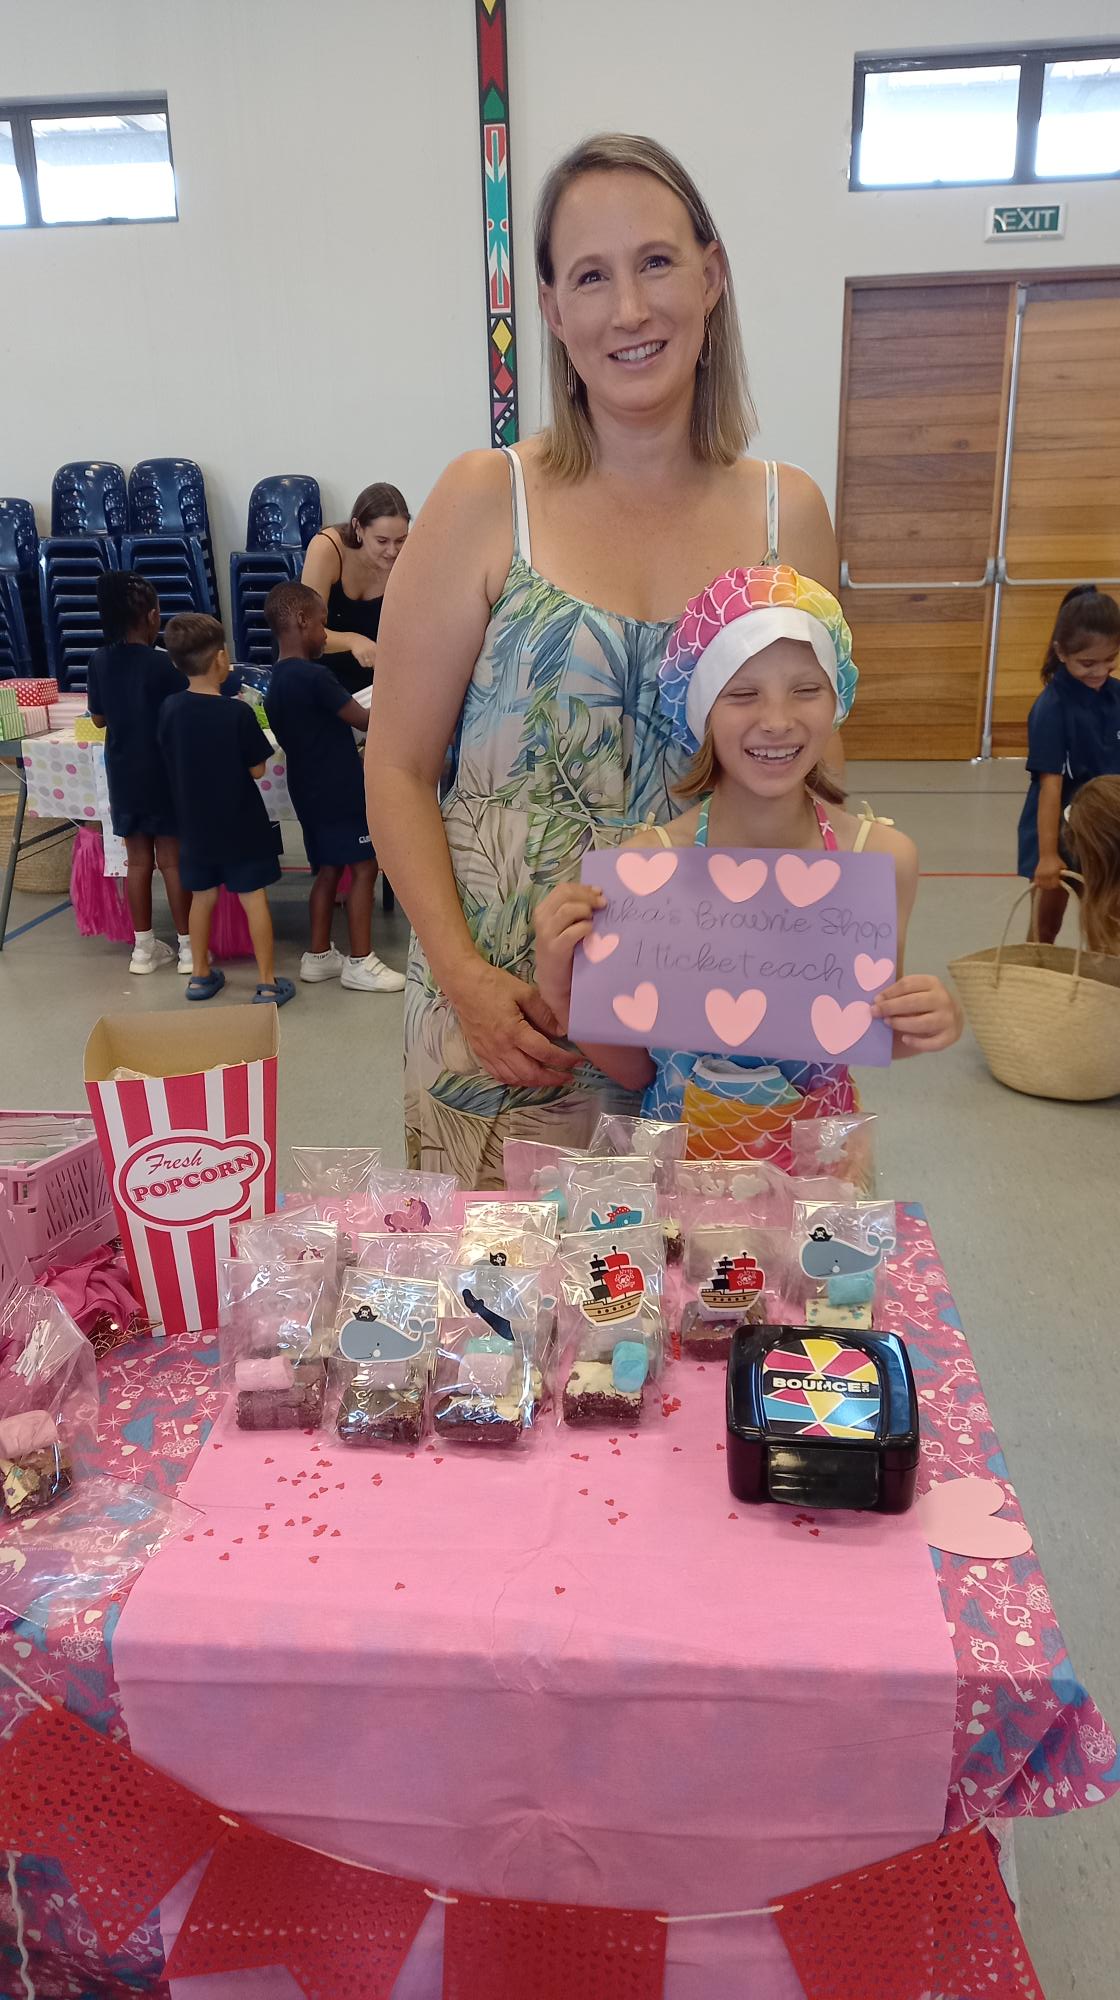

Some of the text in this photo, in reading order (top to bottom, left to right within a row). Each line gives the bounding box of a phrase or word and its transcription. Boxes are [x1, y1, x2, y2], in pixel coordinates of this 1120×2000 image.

[1002, 208, 1055, 230] EXIT
[692, 901, 813, 933] Brownie
[819, 907, 892, 950] Shop
[759, 952, 844, 990] each
[132, 1153, 254, 1202] POPCORN
[145, 1149, 204, 1175] Fresh
[772, 1377, 861, 1393] BOUNCE
